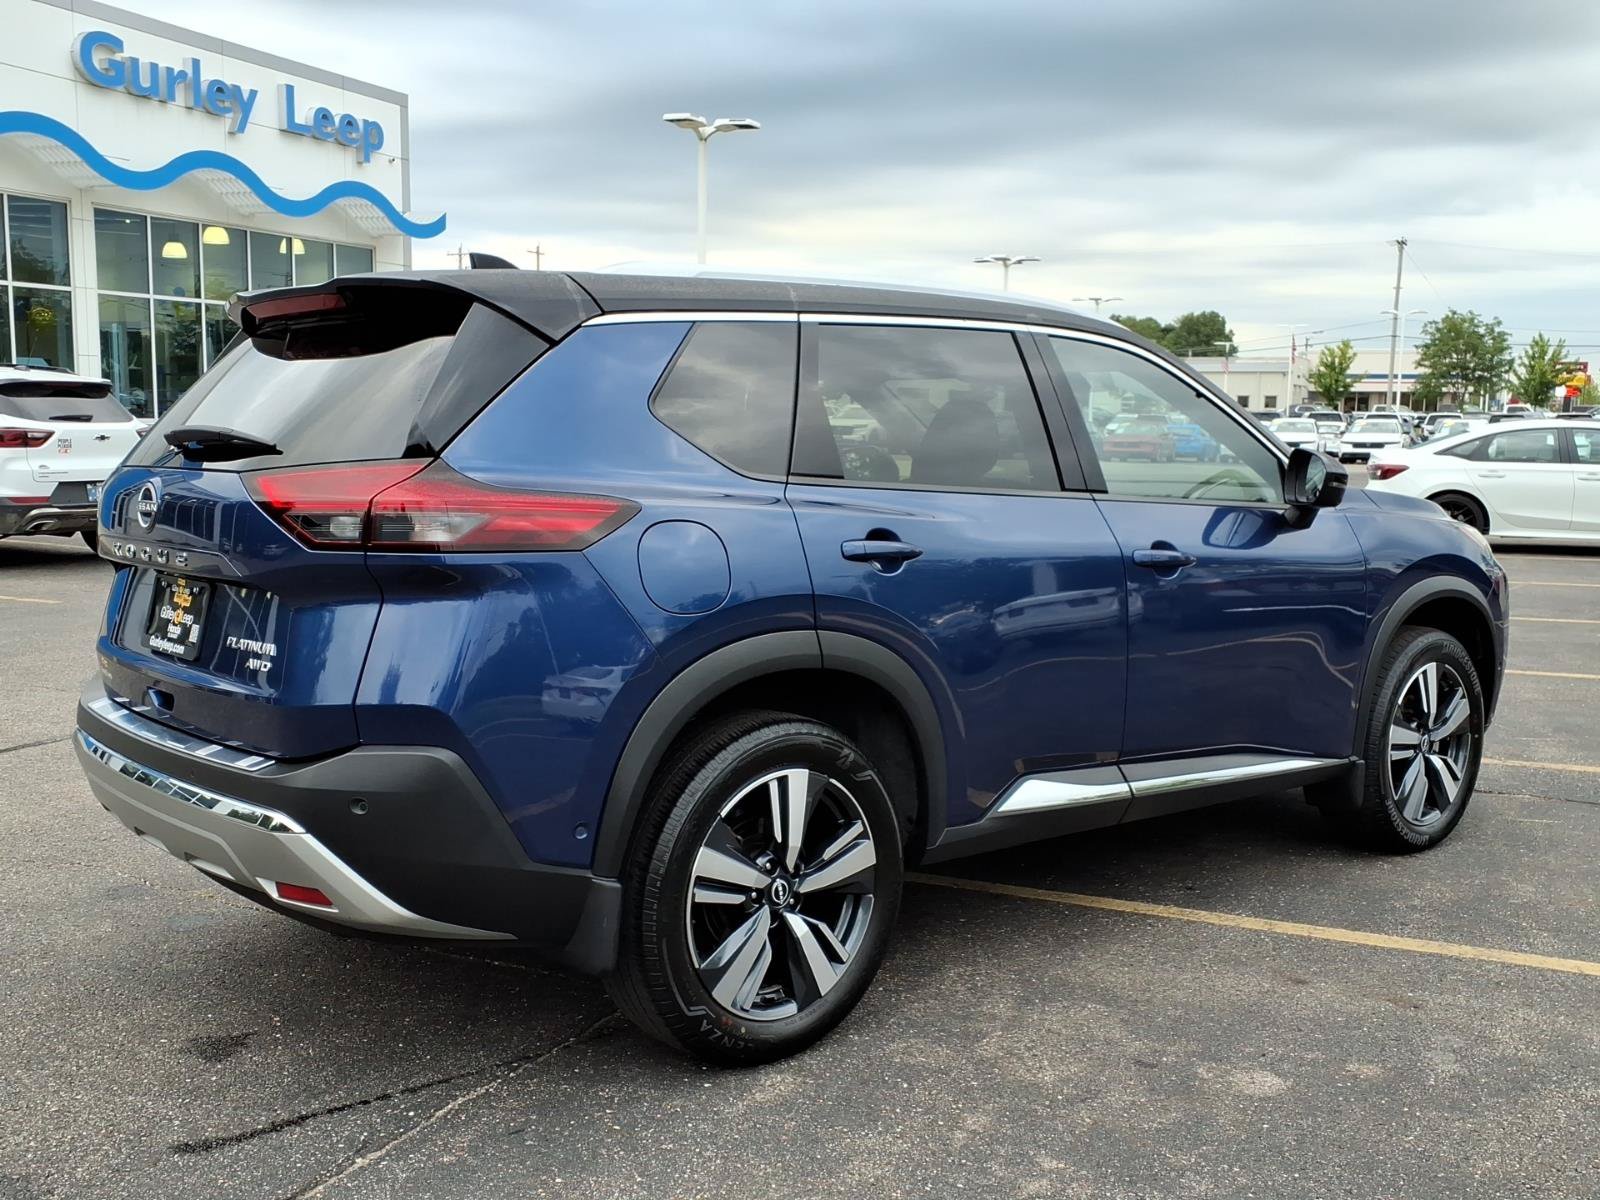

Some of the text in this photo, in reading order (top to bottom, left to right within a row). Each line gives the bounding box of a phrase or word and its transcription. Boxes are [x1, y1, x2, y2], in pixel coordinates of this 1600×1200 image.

[72, 31, 385, 163] Gurley Leep
[136, 501, 157, 512] SSAN
[112, 541, 189, 567] ROGUE
[226, 636, 277, 656] PLATINUM
[244, 658, 273, 672] AWD
